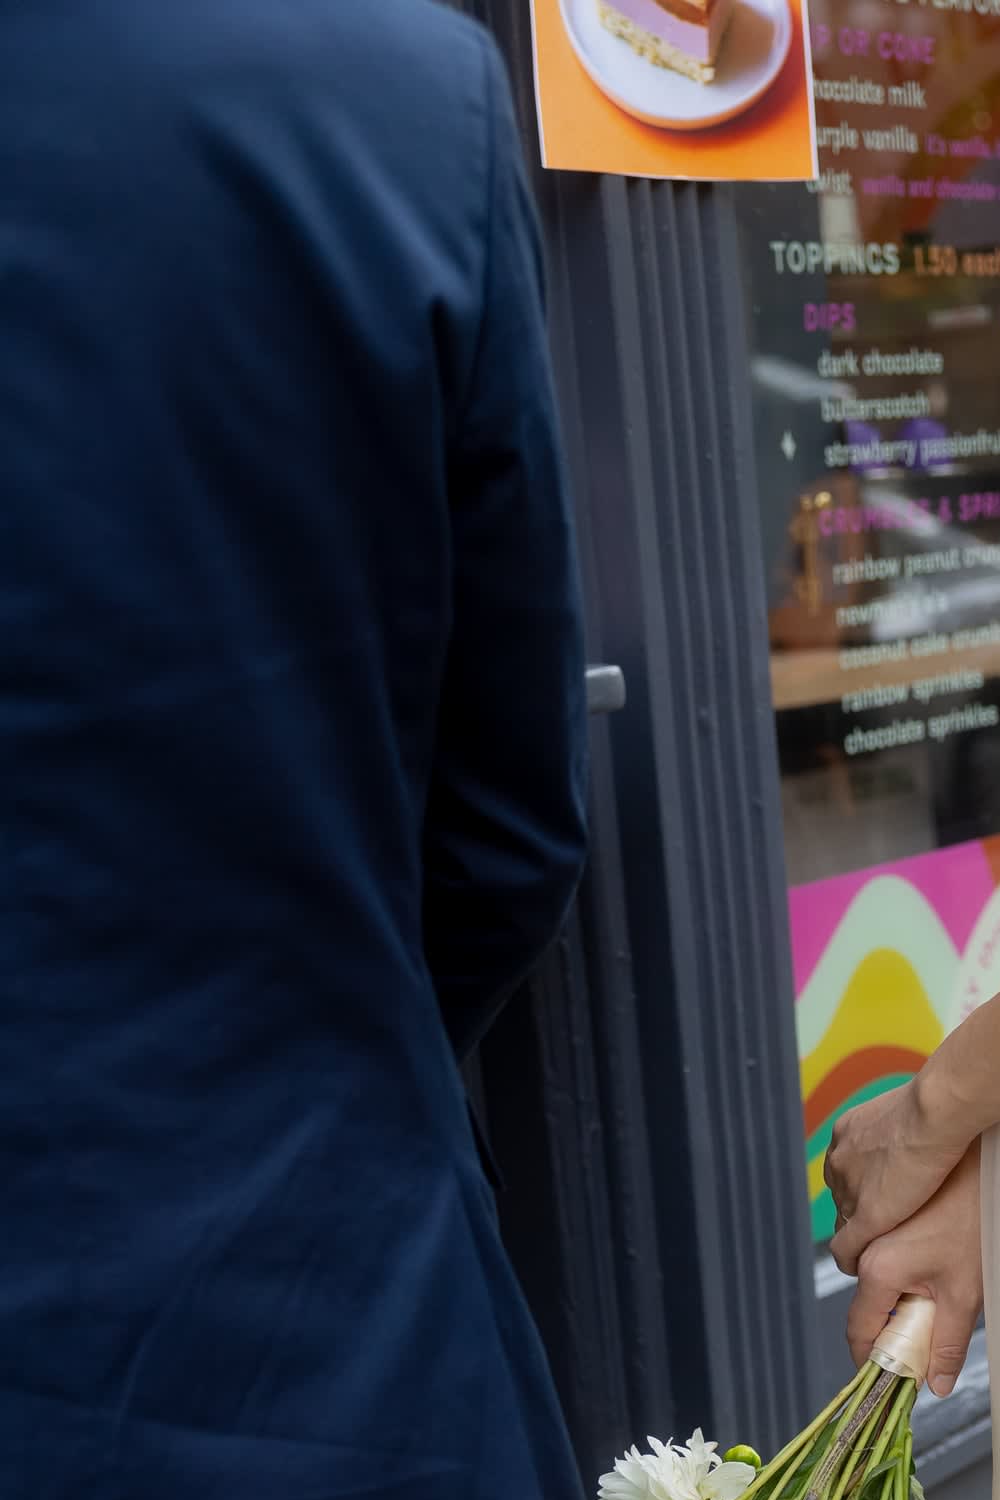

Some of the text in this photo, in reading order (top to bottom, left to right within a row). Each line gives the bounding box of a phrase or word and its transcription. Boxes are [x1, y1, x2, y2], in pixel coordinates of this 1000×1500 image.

[838, 28, 869, 56] OR
[879, 31, 935, 64] CONE
[812, 76, 927, 108] hocolate milk
[816, 119, 858, 155] urple
[862, 125, 919, 153] vanilla
[769, 240, 900, 274] TOPPINGS
[913, 244, 957, 277] 1.50
[803, 303, 857, 332] DIPS
[817, 347, 944, 377] dark chocolate
[820, 389, 930, 423] butterscotch
[824, 437, 918, 467] strawberry
[833, 553, 900, 585] rainbow
[904, 545, 962, 579] peanut
[841, 666, 984, 713] rainbow sprinkles
[844, 702, 999, 755] chocolate sprinkles
